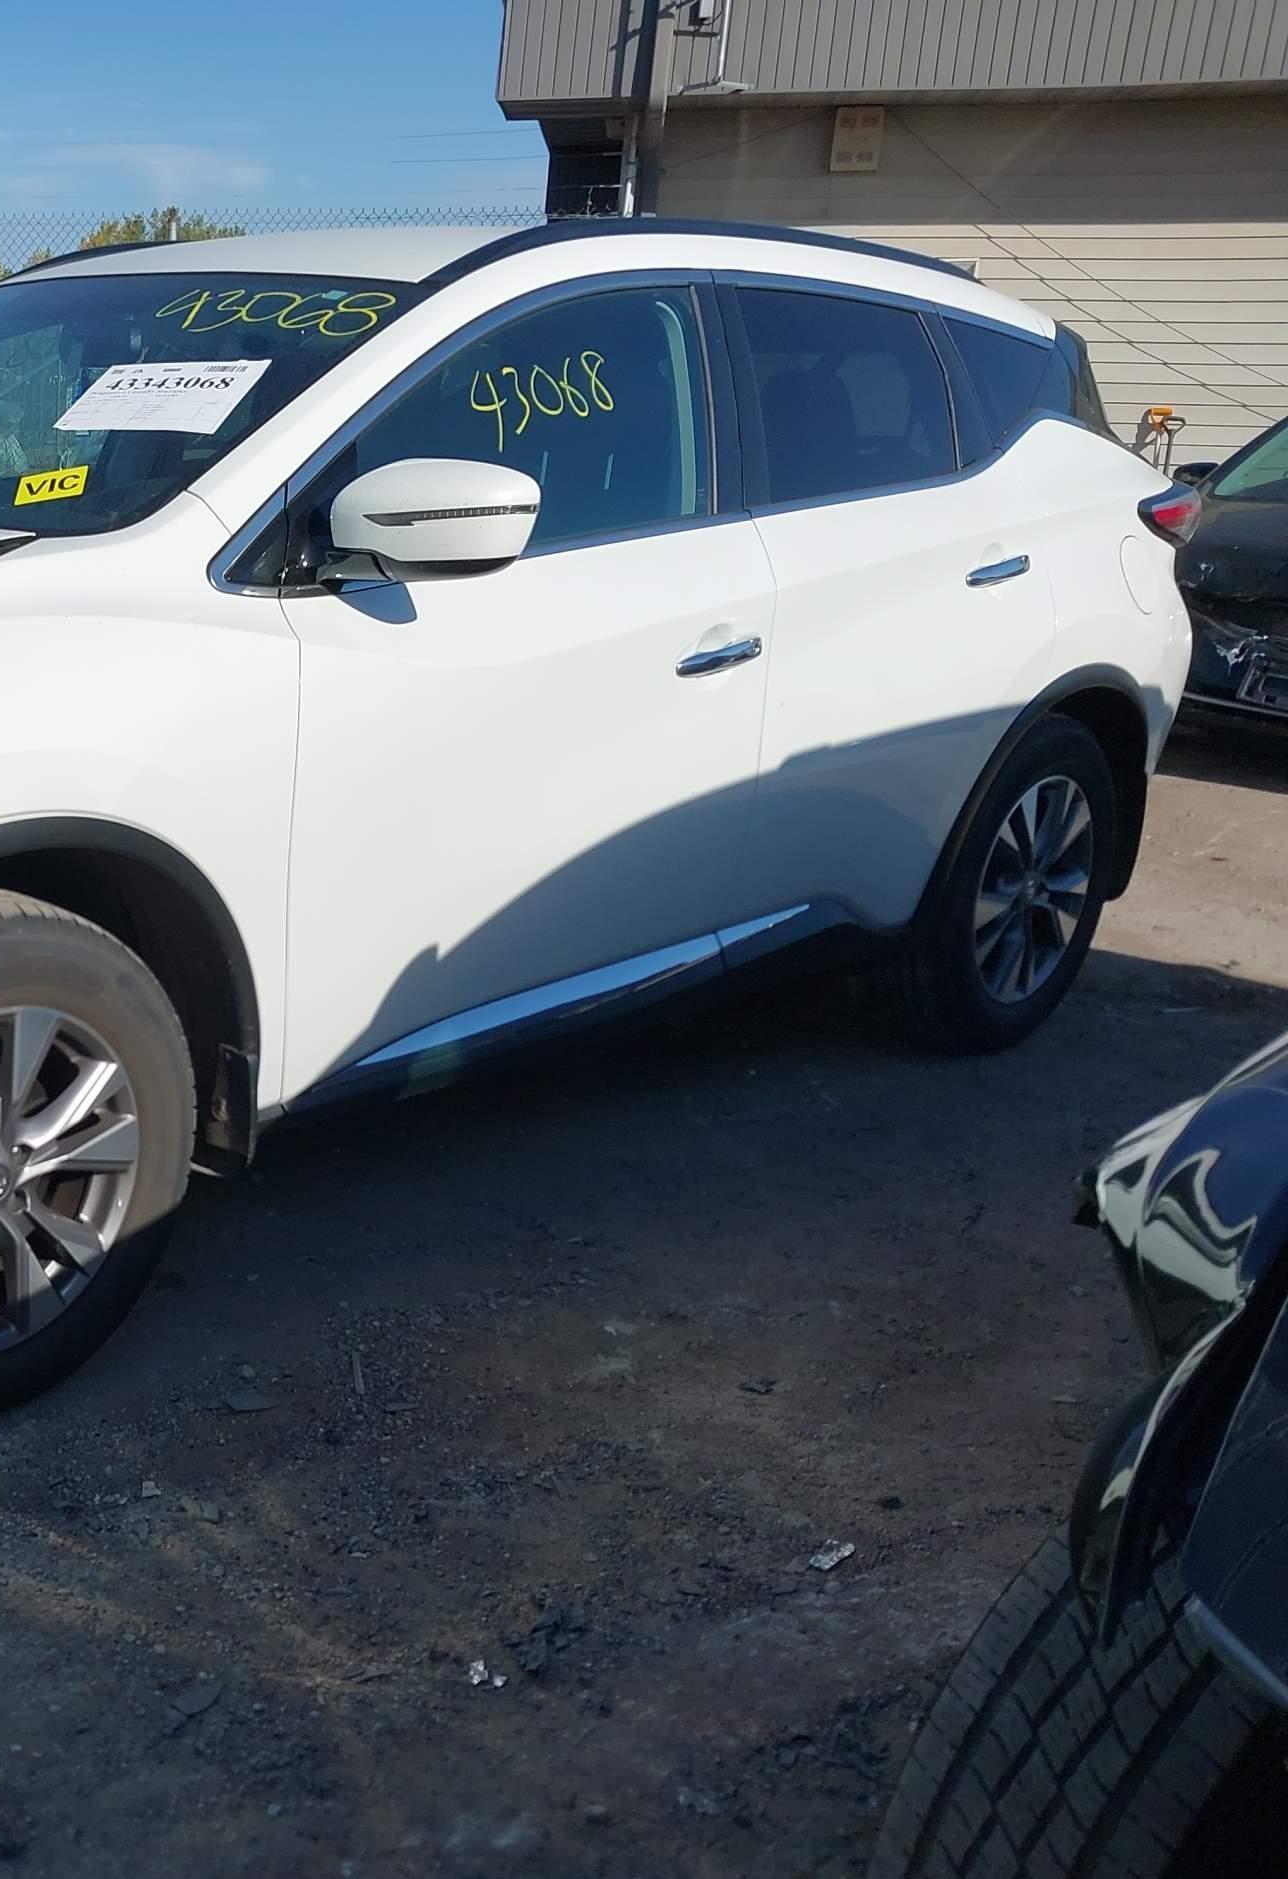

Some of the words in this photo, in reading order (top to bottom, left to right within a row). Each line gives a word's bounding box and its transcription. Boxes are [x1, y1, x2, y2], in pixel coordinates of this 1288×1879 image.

[155, 288, 397, 336] 43068
[105, 376, 235, 391] 43343068
[471, 351, 614, 453] 43068
[25, 474, 81, 497] VIC
